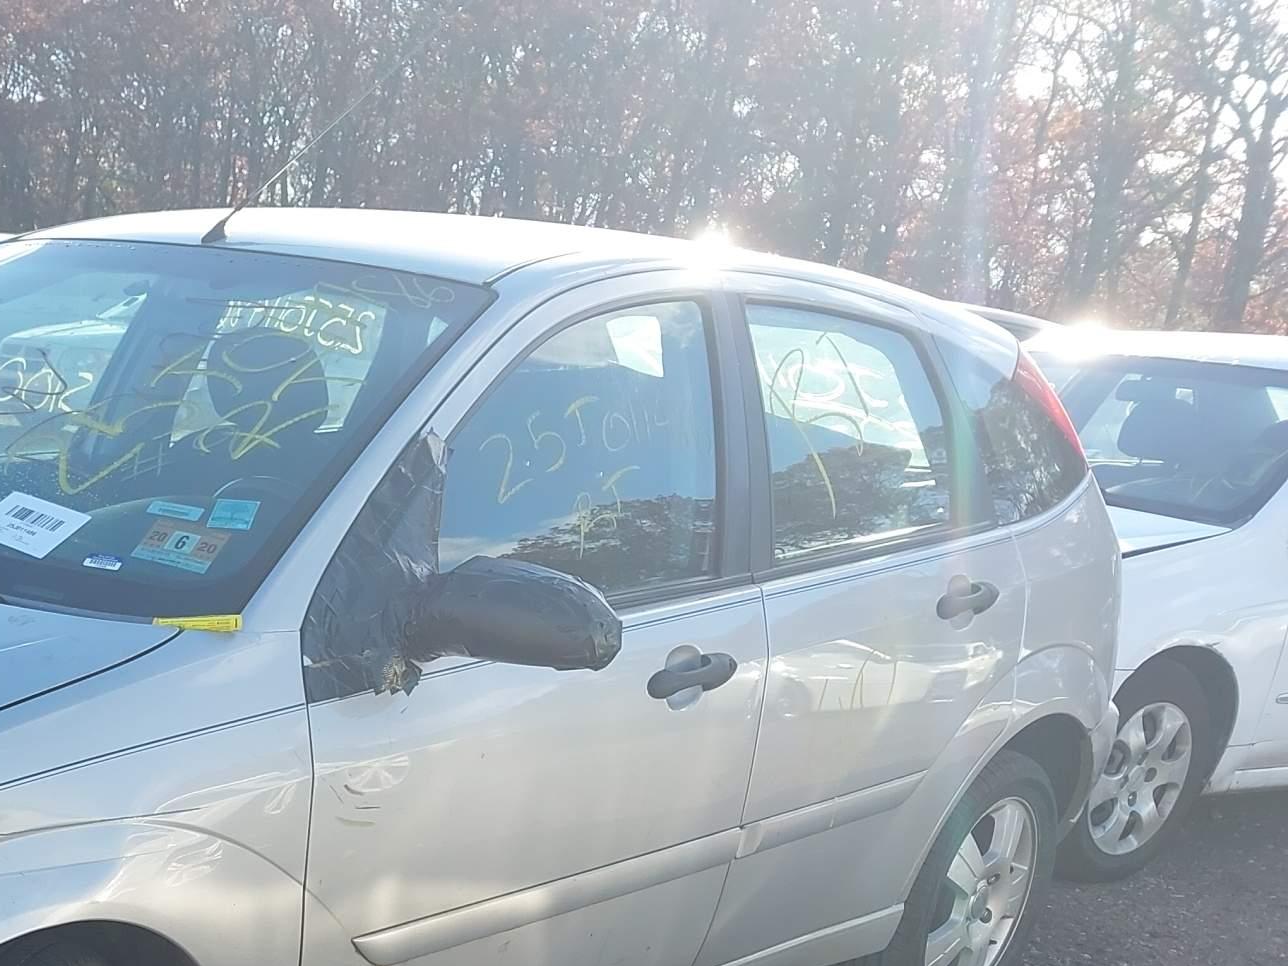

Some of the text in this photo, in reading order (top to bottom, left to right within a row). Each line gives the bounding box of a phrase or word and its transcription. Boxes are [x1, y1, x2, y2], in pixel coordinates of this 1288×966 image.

[149, 530, 217, 554] 20 6 20
